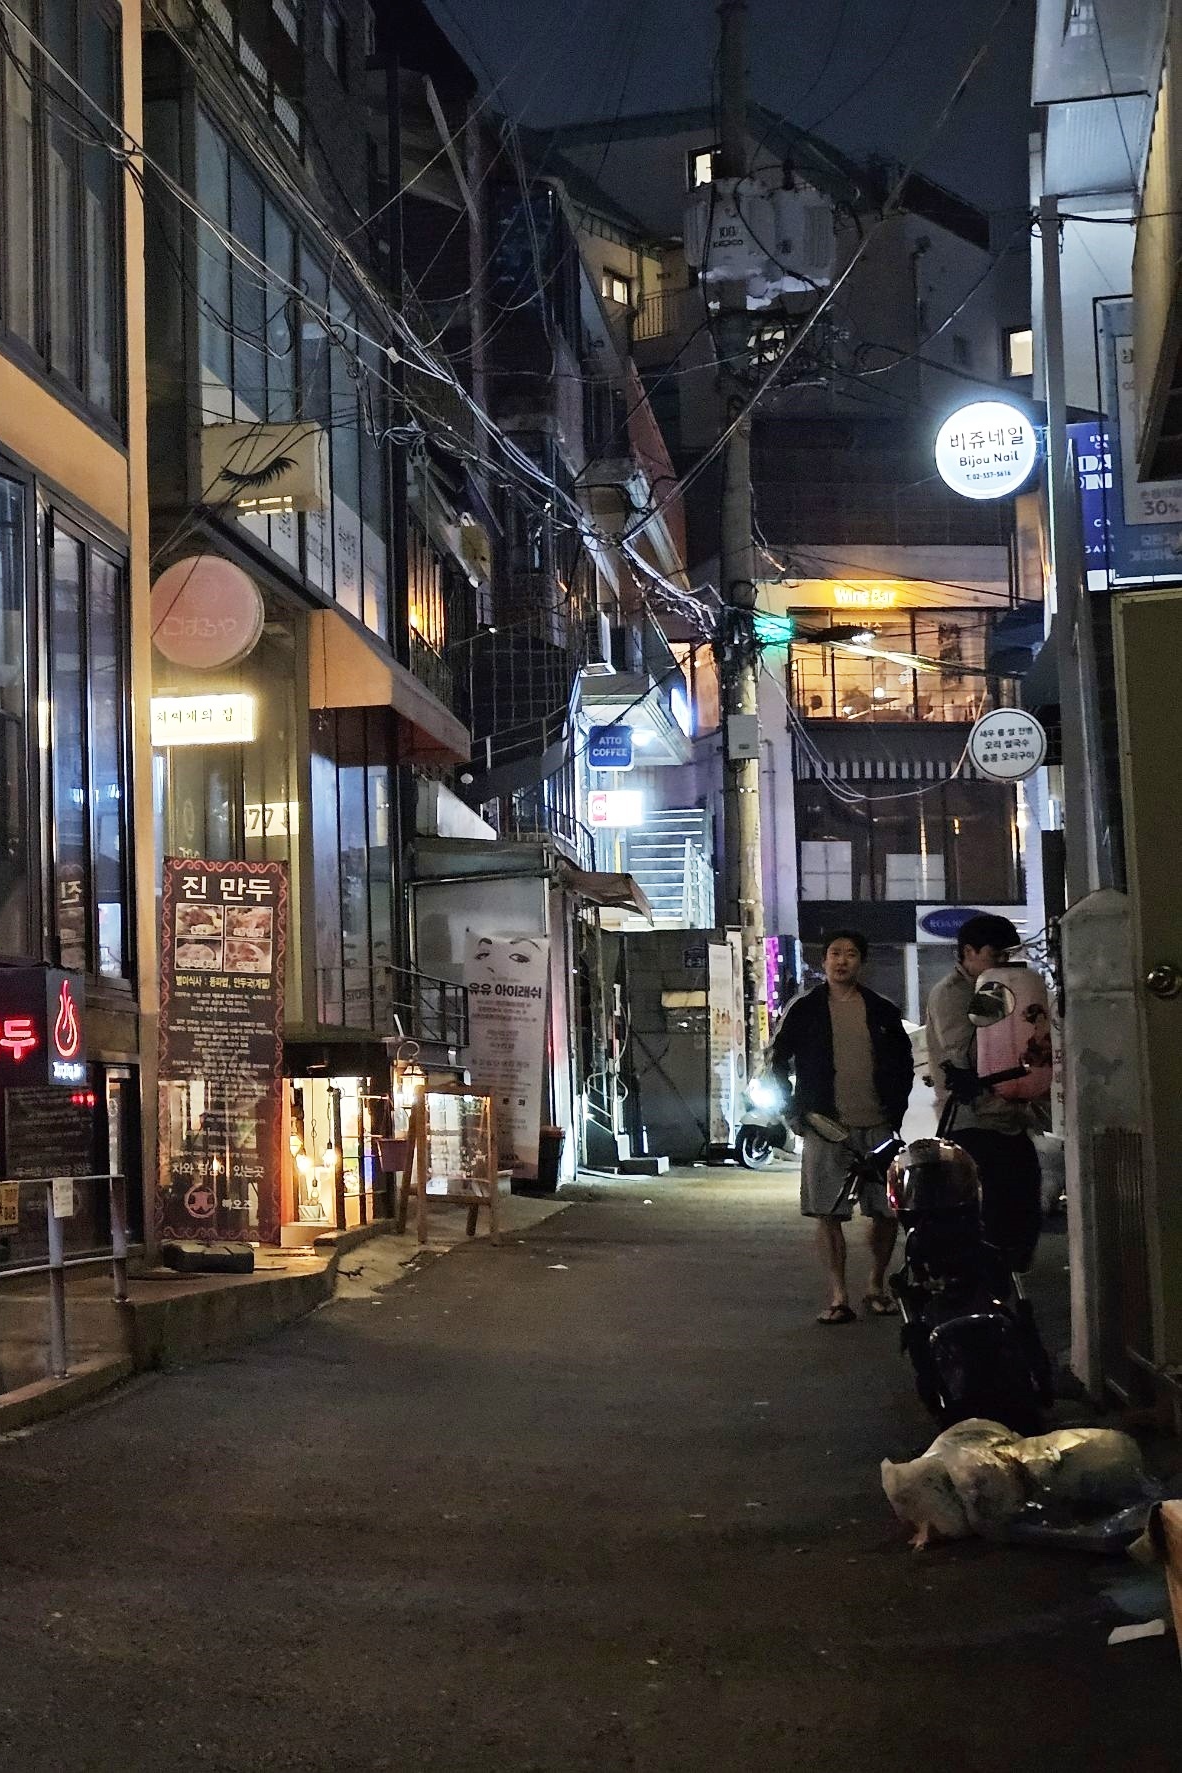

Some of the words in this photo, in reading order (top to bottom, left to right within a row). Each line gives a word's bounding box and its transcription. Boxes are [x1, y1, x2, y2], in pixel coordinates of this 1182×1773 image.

[950, 426, 1024, 450] 비쥬네일
[959, 455, 990, 468] Bijou
[994, 450, 1019, 462] Nail
[834, 586, 869, 606] Wine
[871, 588, 895, 606] Bar
[599, 736, 622, 745] ATTO
[985, 740, 1001, 749] 오리
[592, 748, 628, 757] COFFEE
[181, 876, 207, 899] 진
[220, 877, 273, 902] 만두
[468, 982, 492, 996] 유유
[495, 983, 542, 999] 아이래쉬
